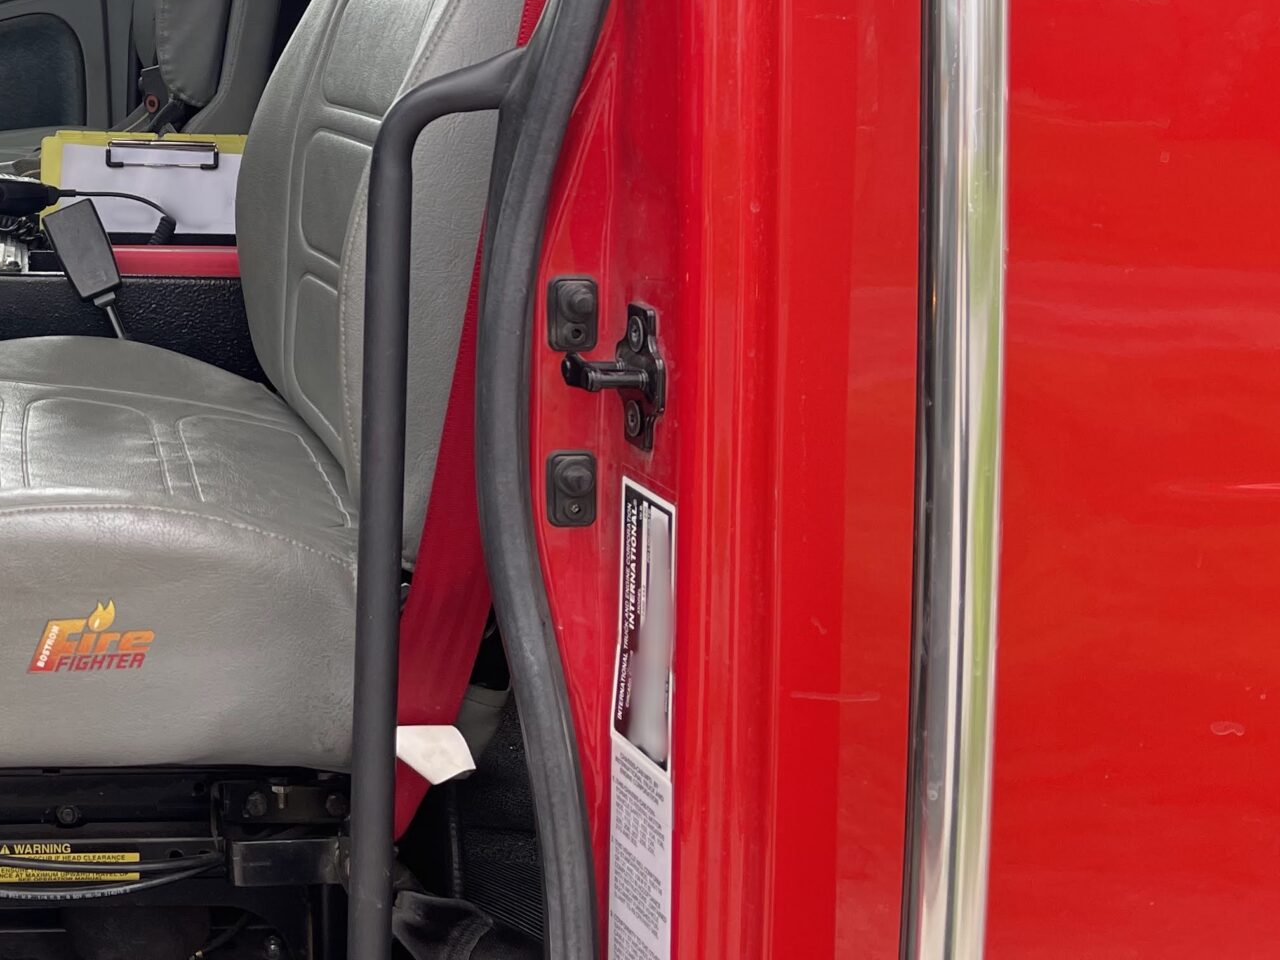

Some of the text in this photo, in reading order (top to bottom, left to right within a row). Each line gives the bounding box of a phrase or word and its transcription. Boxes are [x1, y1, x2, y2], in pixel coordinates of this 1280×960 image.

[625, 502, 633, 566] CORPORATION
[623, 619, 631, 650] TRUCK
[54, 652, 147, 673] FIGHTER
[616, 652, 628, 720] INTERNATIONAL
[13, 843, 72, 855] WARNING
